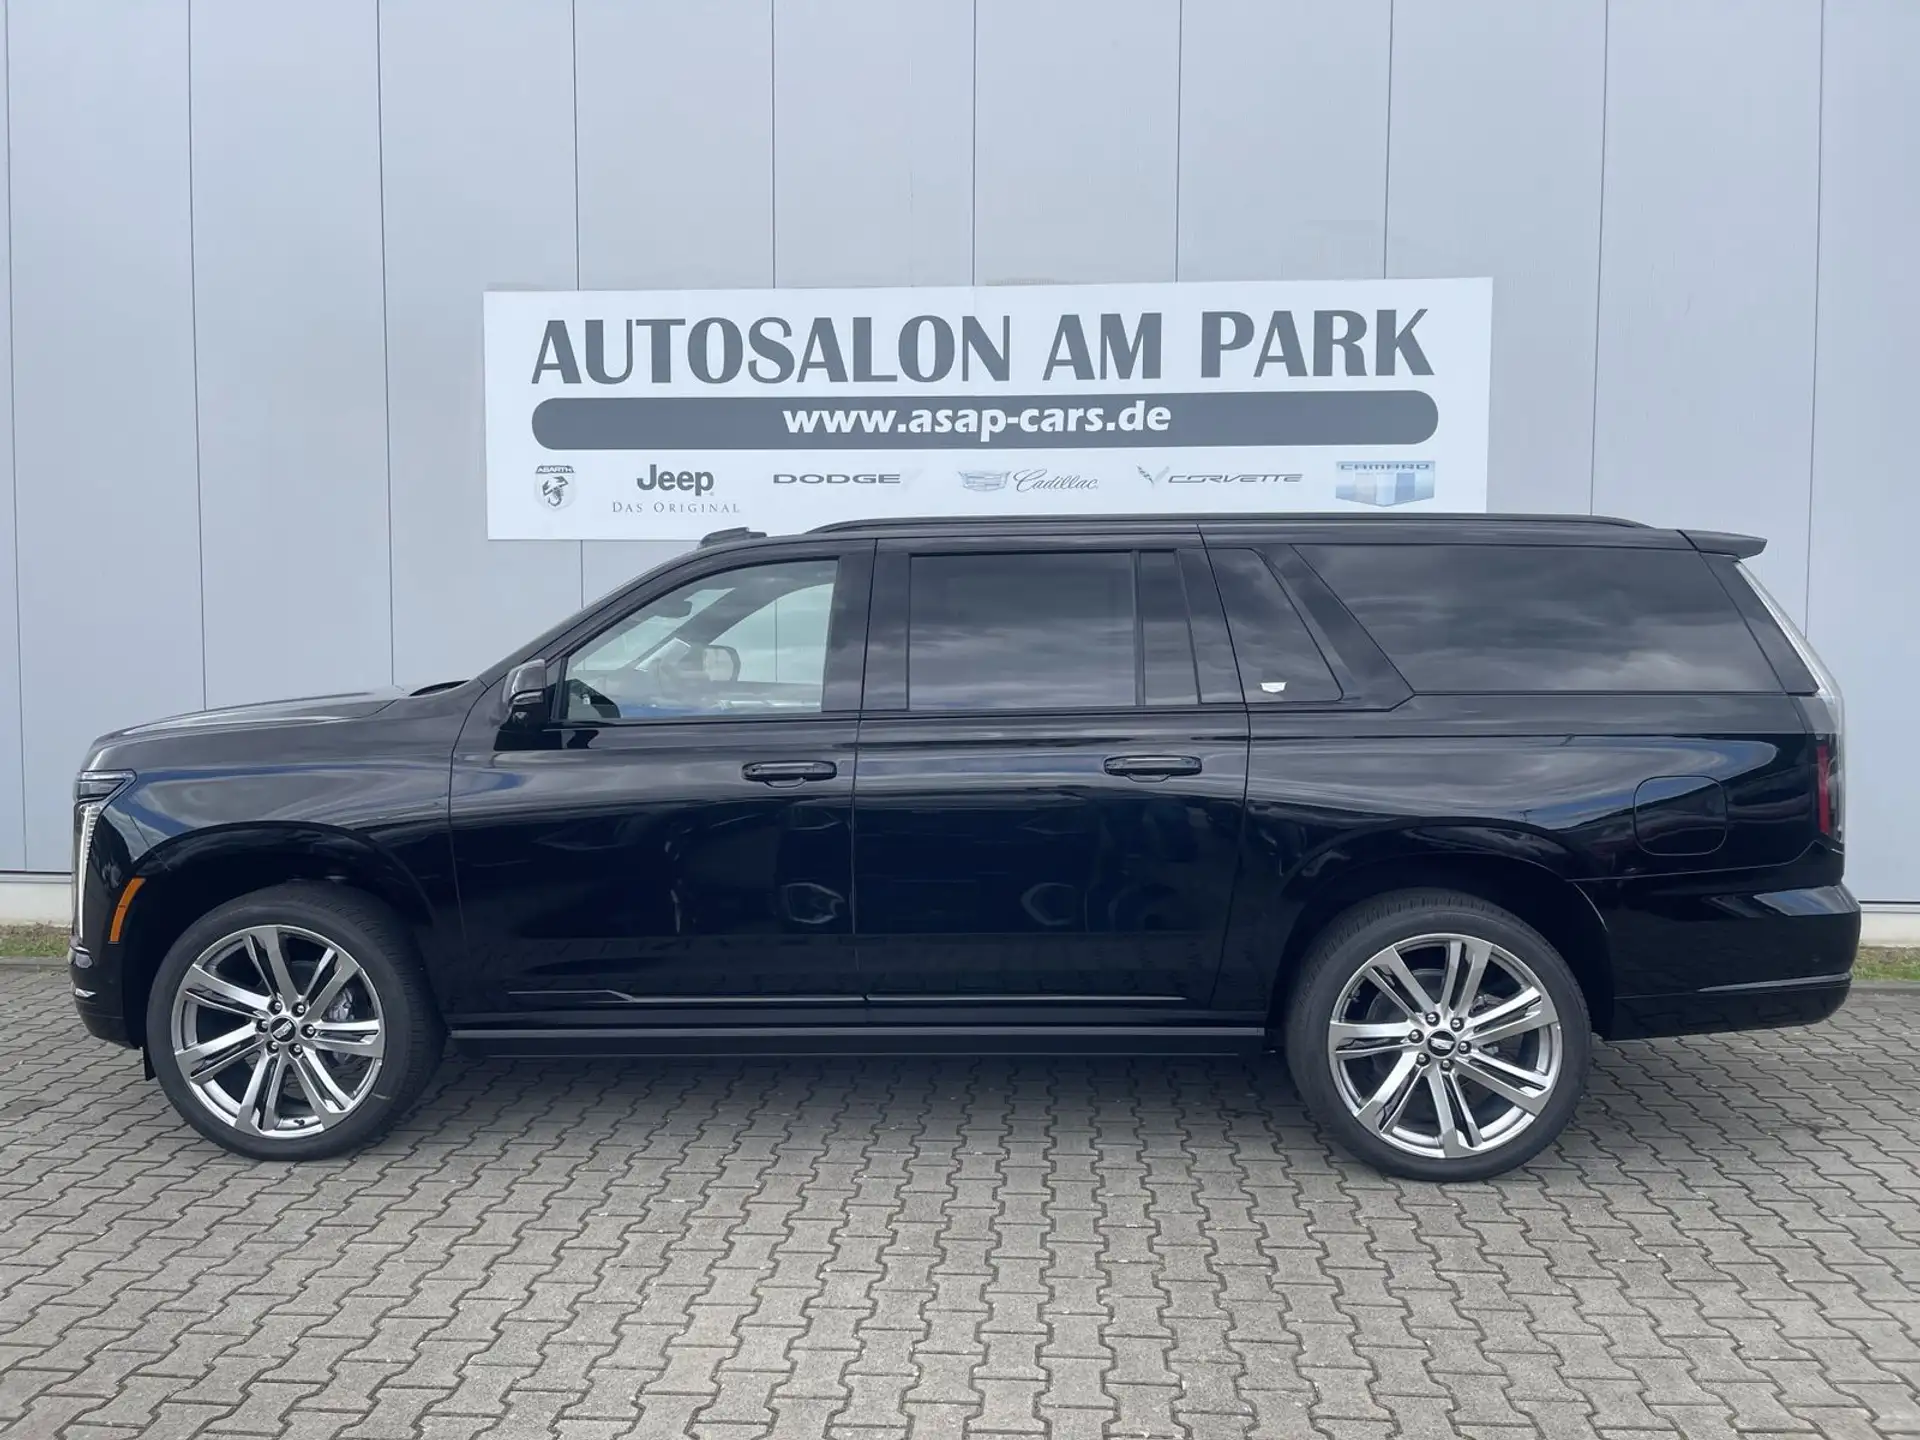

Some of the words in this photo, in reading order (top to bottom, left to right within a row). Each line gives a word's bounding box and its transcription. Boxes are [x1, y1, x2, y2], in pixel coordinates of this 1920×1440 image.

[531, 315, 1010, 385] AUTOSALON
[1042, 312, 1162, 381] AM
[1200, 308, 1436, 378] PARK
[782, 400, 1172, 443] www.asap-cars.de
[537, 465, 575, 474] ABARTH
[1340, 463, 1431, 471] CAMARO
[636, 463, 715, 497] Jeep
[773, 473, 901, 485] DODGE
[1012, 468, 1100, 493] Cadillac
[1167, 473, 1304, 484] CORVETTE
